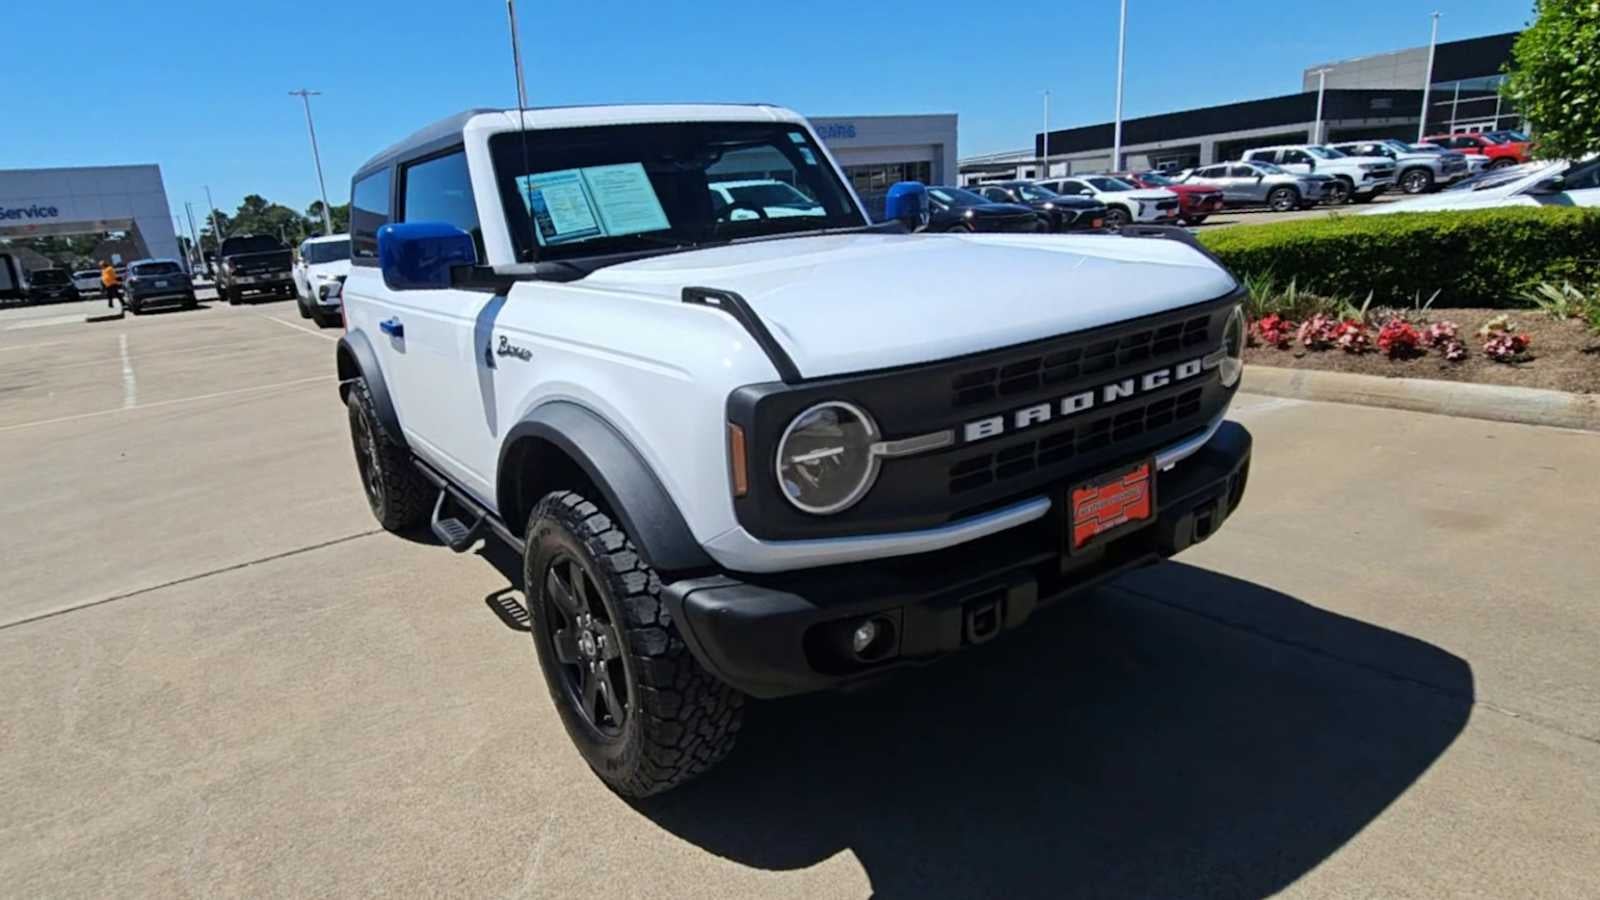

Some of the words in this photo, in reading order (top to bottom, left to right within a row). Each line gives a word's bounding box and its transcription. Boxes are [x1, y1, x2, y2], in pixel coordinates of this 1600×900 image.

[816, 123, 856, 138] CARS
[0, 204, 58, 220] Service
[965, 359, 1201, 442] BRONCO
